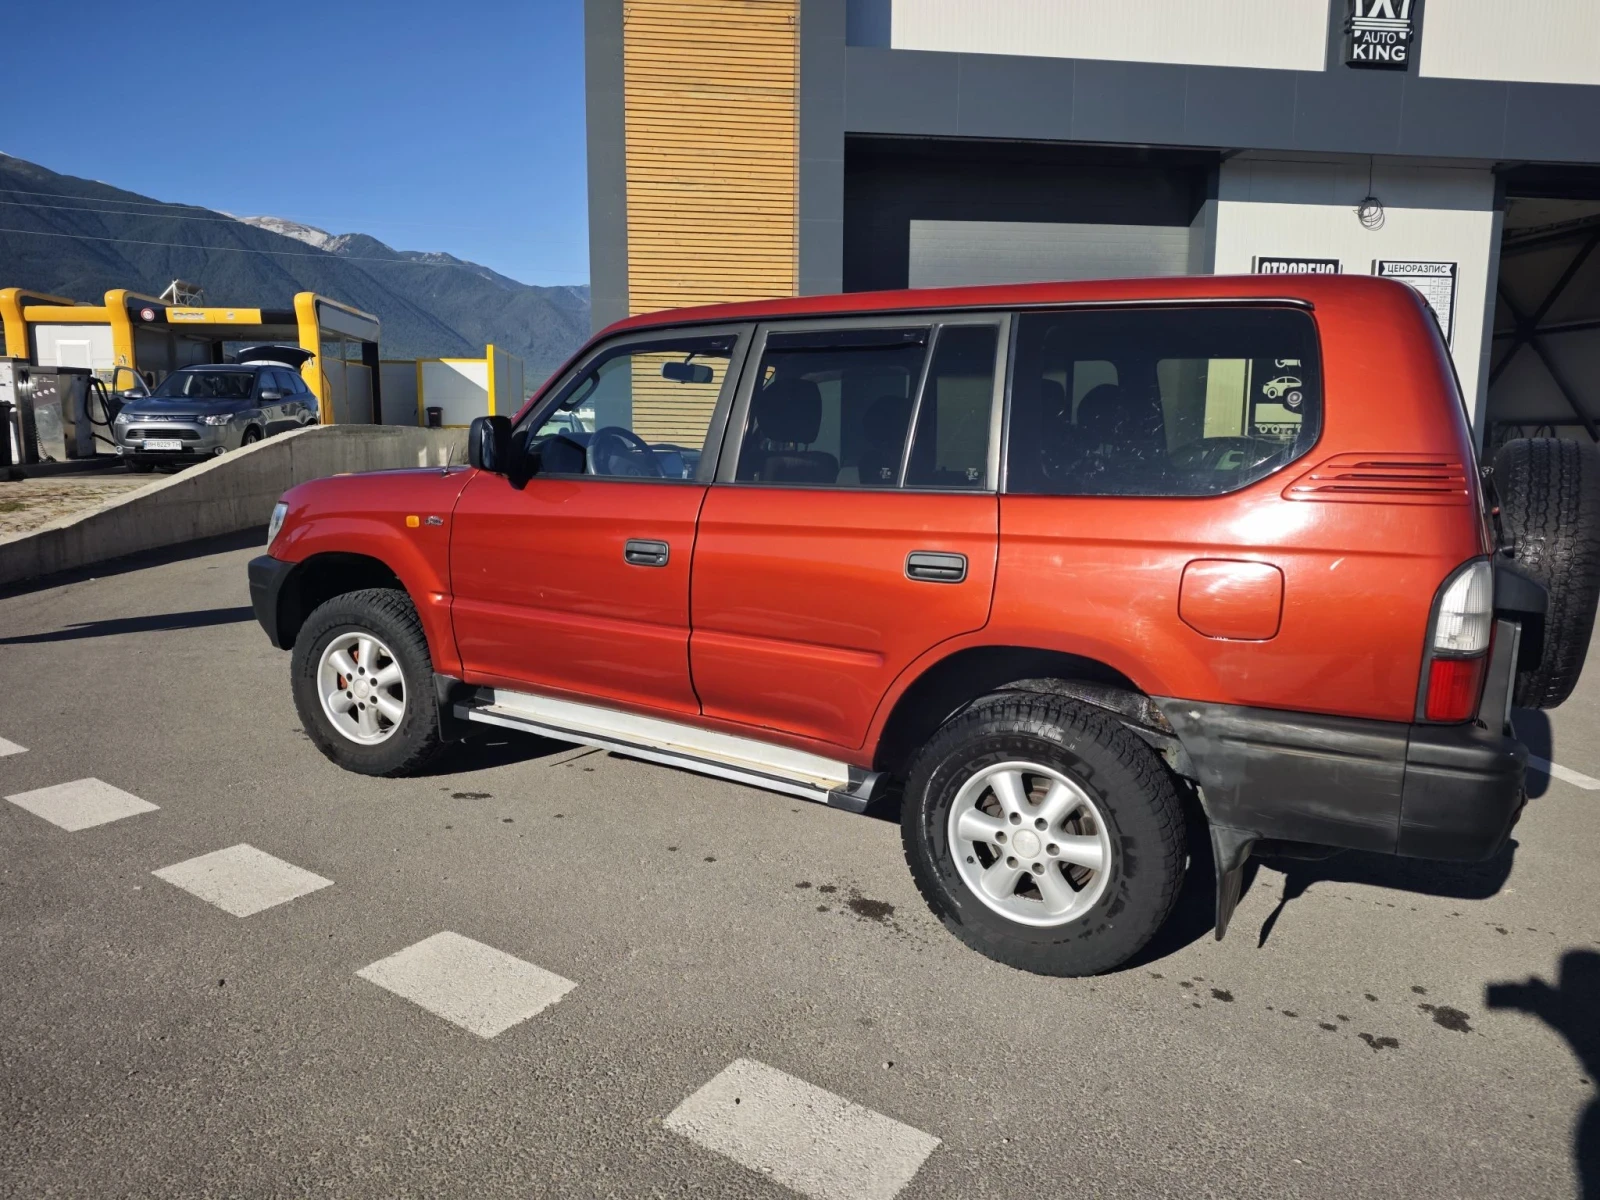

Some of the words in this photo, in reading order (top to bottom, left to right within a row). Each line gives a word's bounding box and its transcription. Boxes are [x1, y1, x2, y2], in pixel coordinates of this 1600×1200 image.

[1362, 31, 1397, 44] AUTO
[1352, 43, 1406, 61] KING
[1387, 264, 1447, 274] ЦЕНОРАЗПИС
